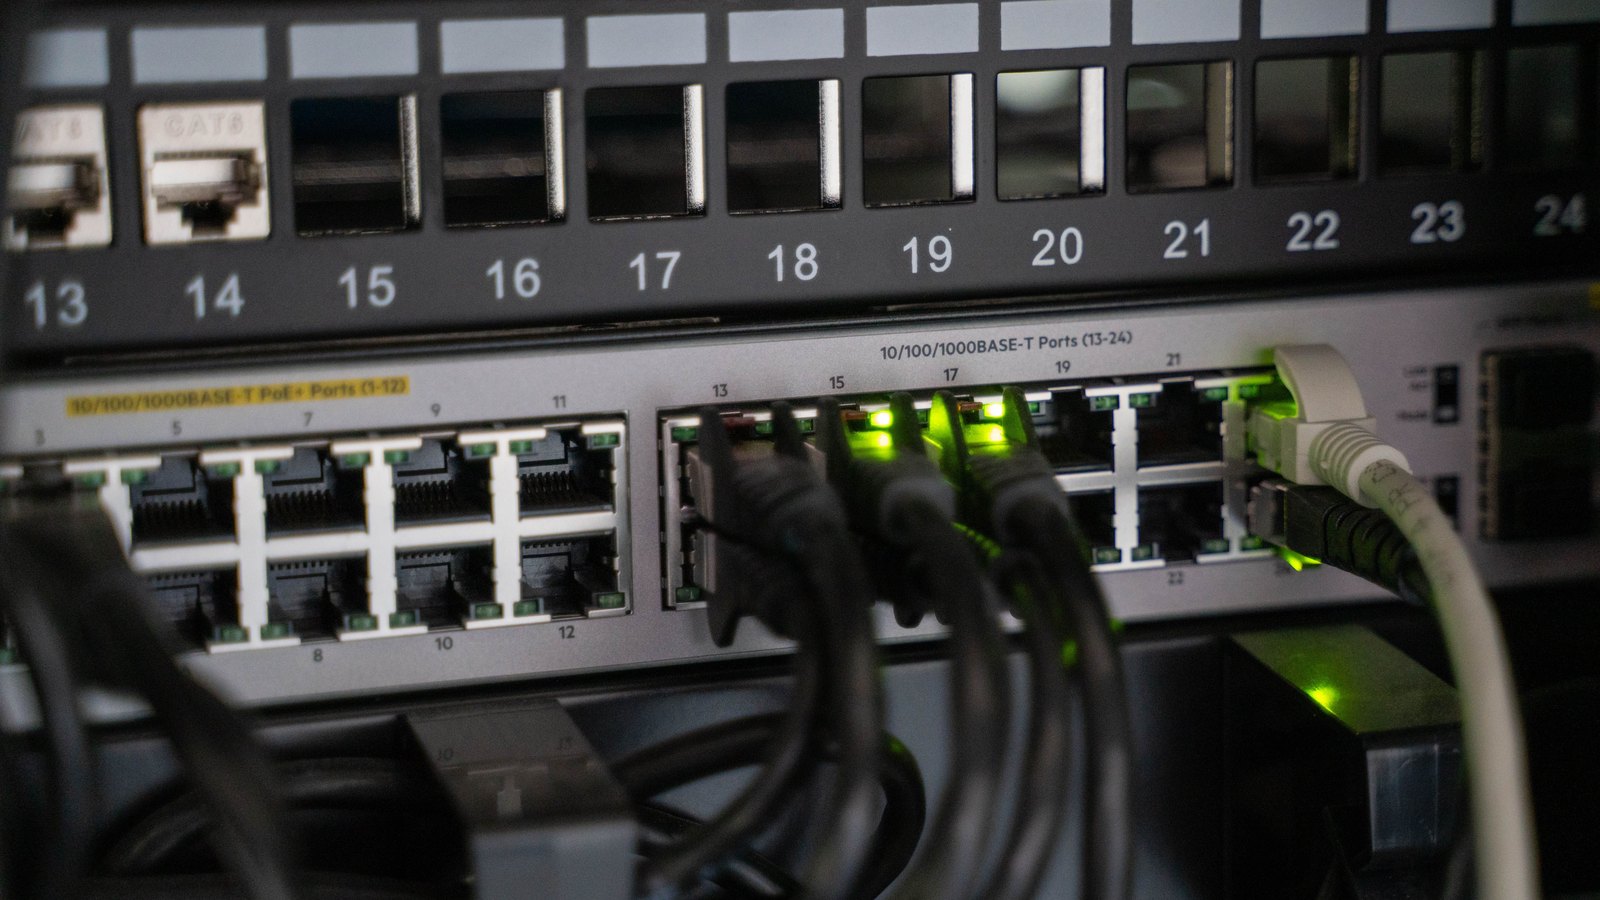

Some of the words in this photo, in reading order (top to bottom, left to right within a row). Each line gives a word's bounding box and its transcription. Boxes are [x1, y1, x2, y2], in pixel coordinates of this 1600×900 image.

[165, 113, 243, 138] CAT6
[1410, 201, 1464, 244] 23
[1534, 195, 1585, 236] 24
[1163, 219, 1209, 259] 21
[1286, 210, 1339, 252] 22
[902, 235, 953, 274] 19
[1031, 226, 1083, 266] 20
[629, 250, 681, 291] 17
[767, 242, 819, 282] 18
[338, 265, 396, 309] 15
[486, 257, 541, 300] 16
[26, 281, 89, 328] 13
[185, 274, 245, 319] 14
[880, 337, 1034, 360] 10/100/1000BASE-T
[1038, 335, 1078, 349] Ports
[1082, 331, 1133, 347] (13-24)
[1166, 352, 1181, 367] 21
[943, 368, 958, 382] 17
[1055, 360, 1071, 373] 19
[72, 387, 252, 415] 10/100/1000BASE-T
[260, 385, 305, 401] PoE+
[310, 383, 356, 397] Ports
[361, 377, 406, 395] (1-12)
[712, 384, 729, 398] 13
[829, 376, 845, 390] 15
[430, 403, 441, 417] 9
[552, 395, 567, 409] 11
[172, 420, 182, 436] 5
[304, 411, 314, 427] 7
[434, 637, 454, 651] 10
[558, 625, 576, 640] 12
[313, 649, 323, 663] 8
